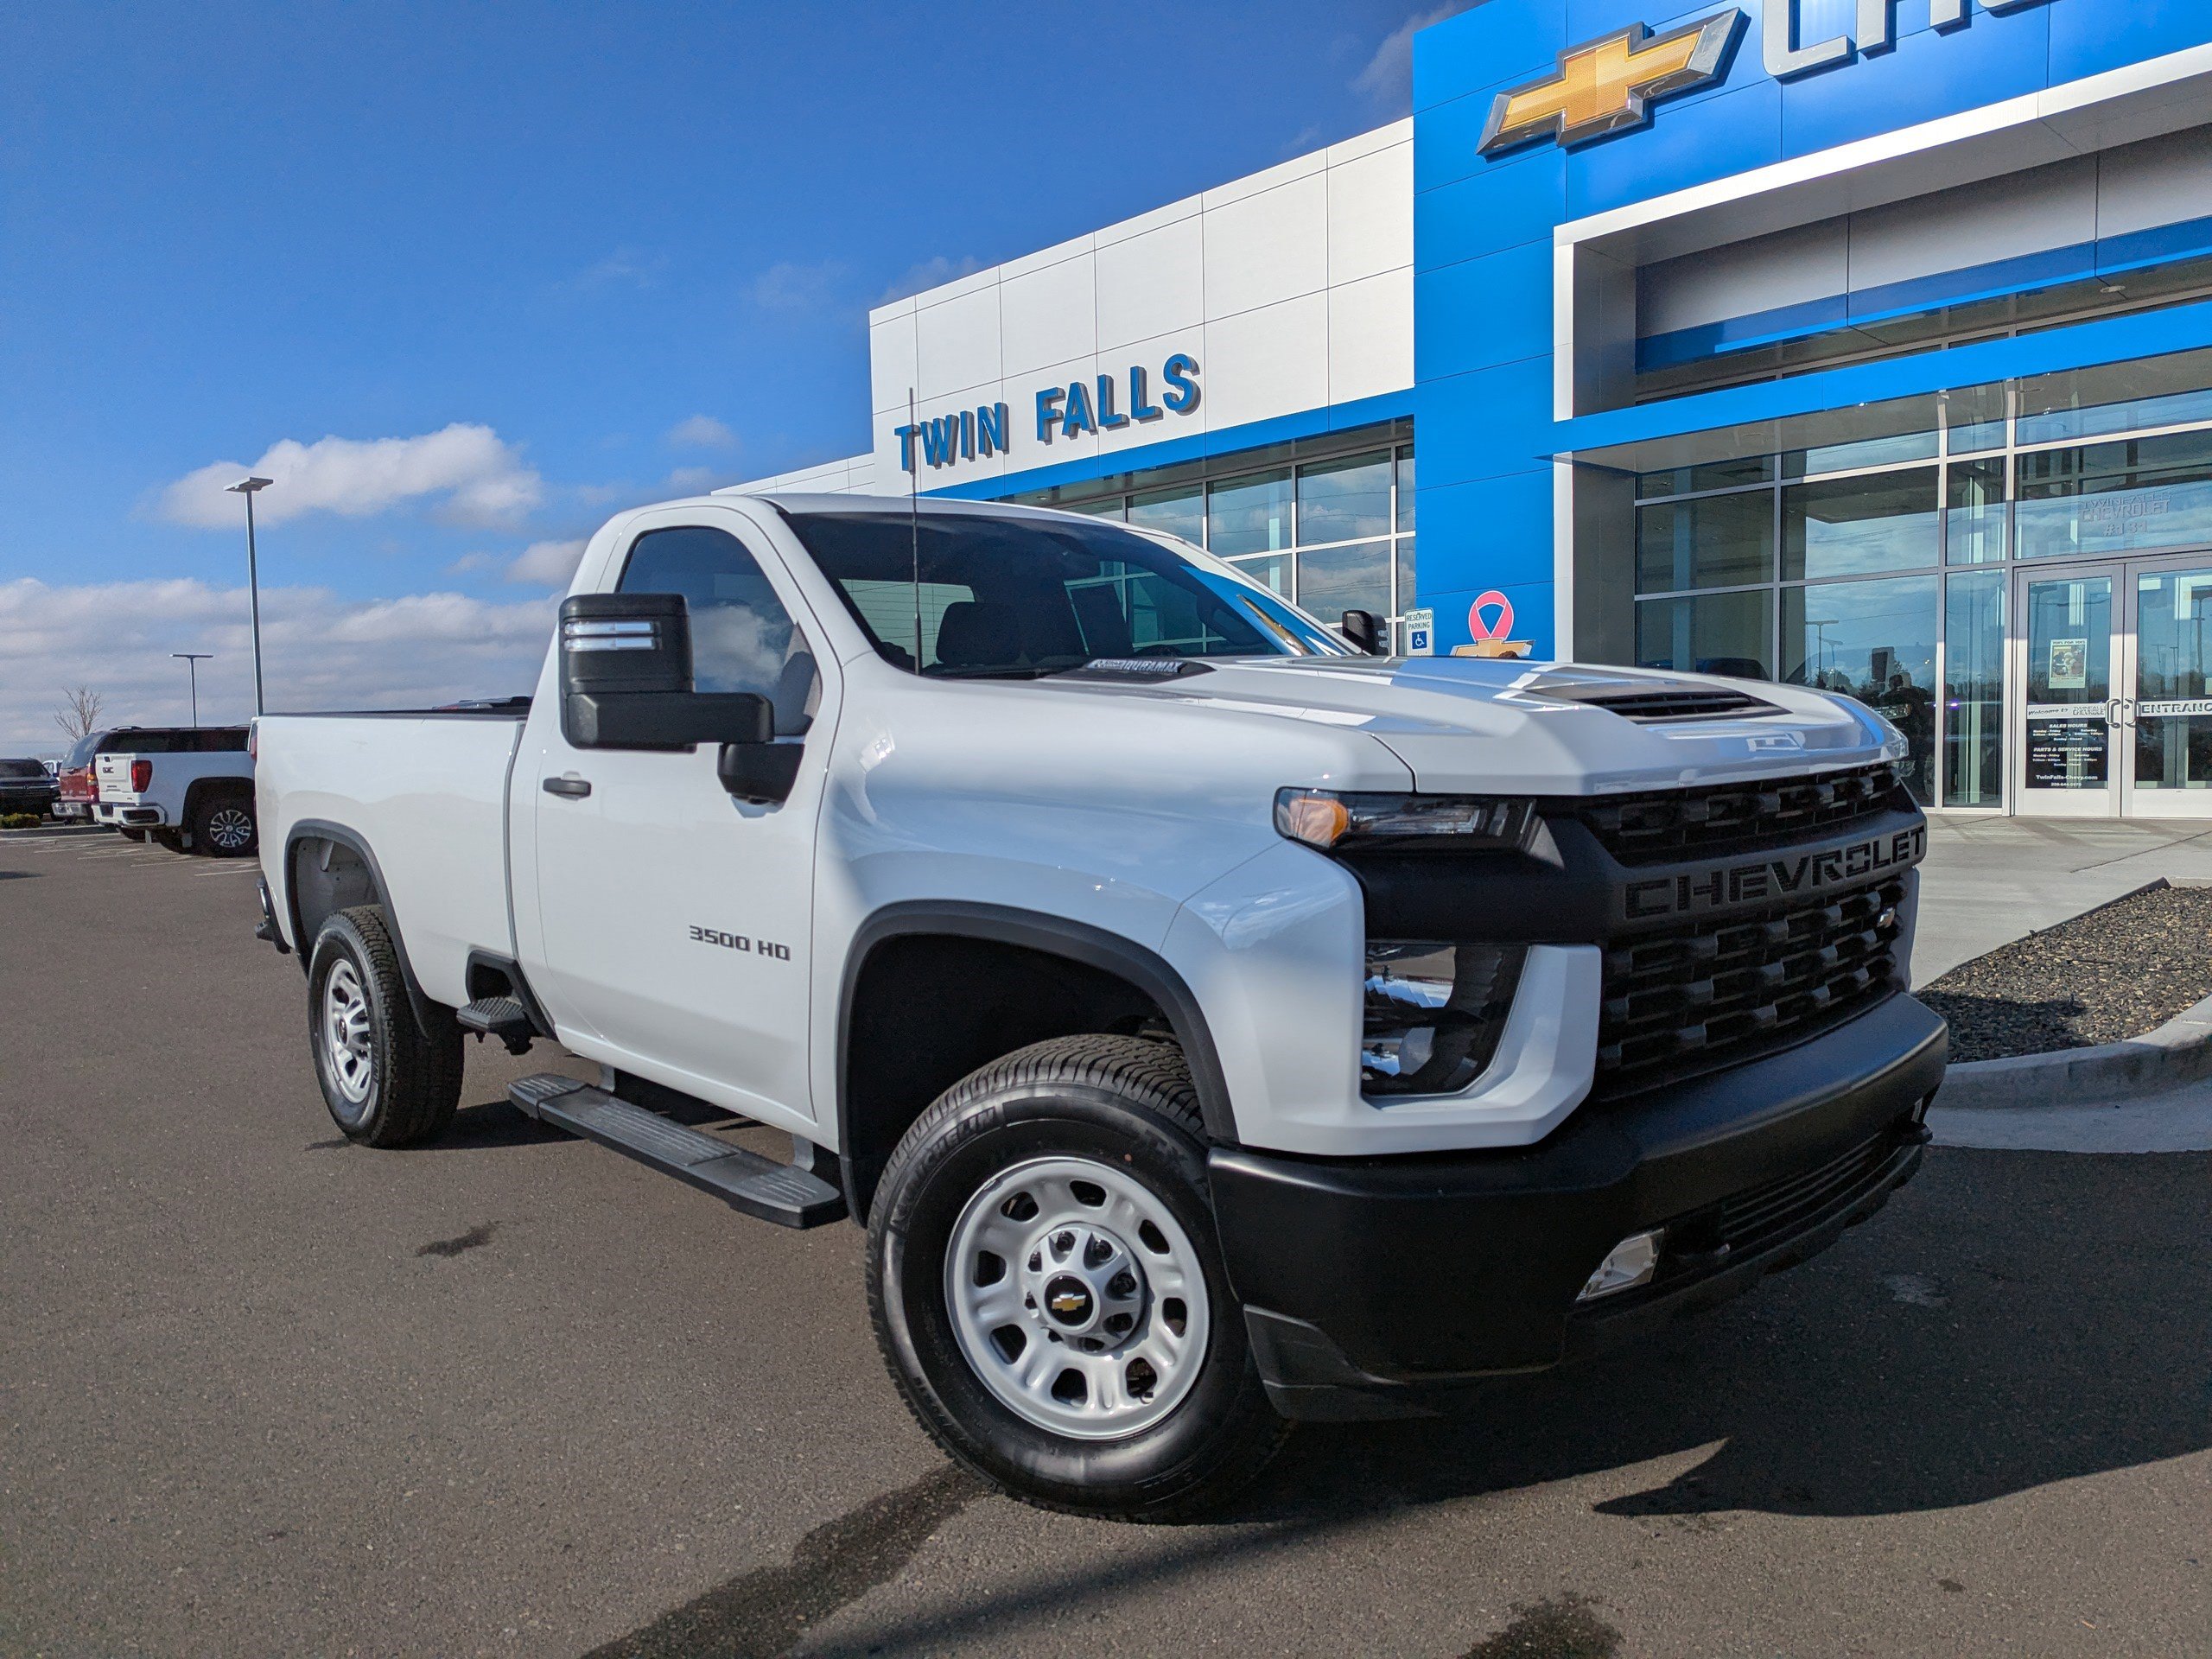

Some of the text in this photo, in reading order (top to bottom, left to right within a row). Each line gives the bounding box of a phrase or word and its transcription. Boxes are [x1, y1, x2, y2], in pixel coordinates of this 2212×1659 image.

[894, 353, 1202, 474] TWIN FALLS
[2078, 500, 2171, 522] CHEVROLET
[1407, 613, 1432, 621] RESERVED
[1124, 659, 1181, 672] DURAMAX
[1624, 825, 1924, 918] CHEVROLET
[690, 925, 791, 961] 3500 HD
